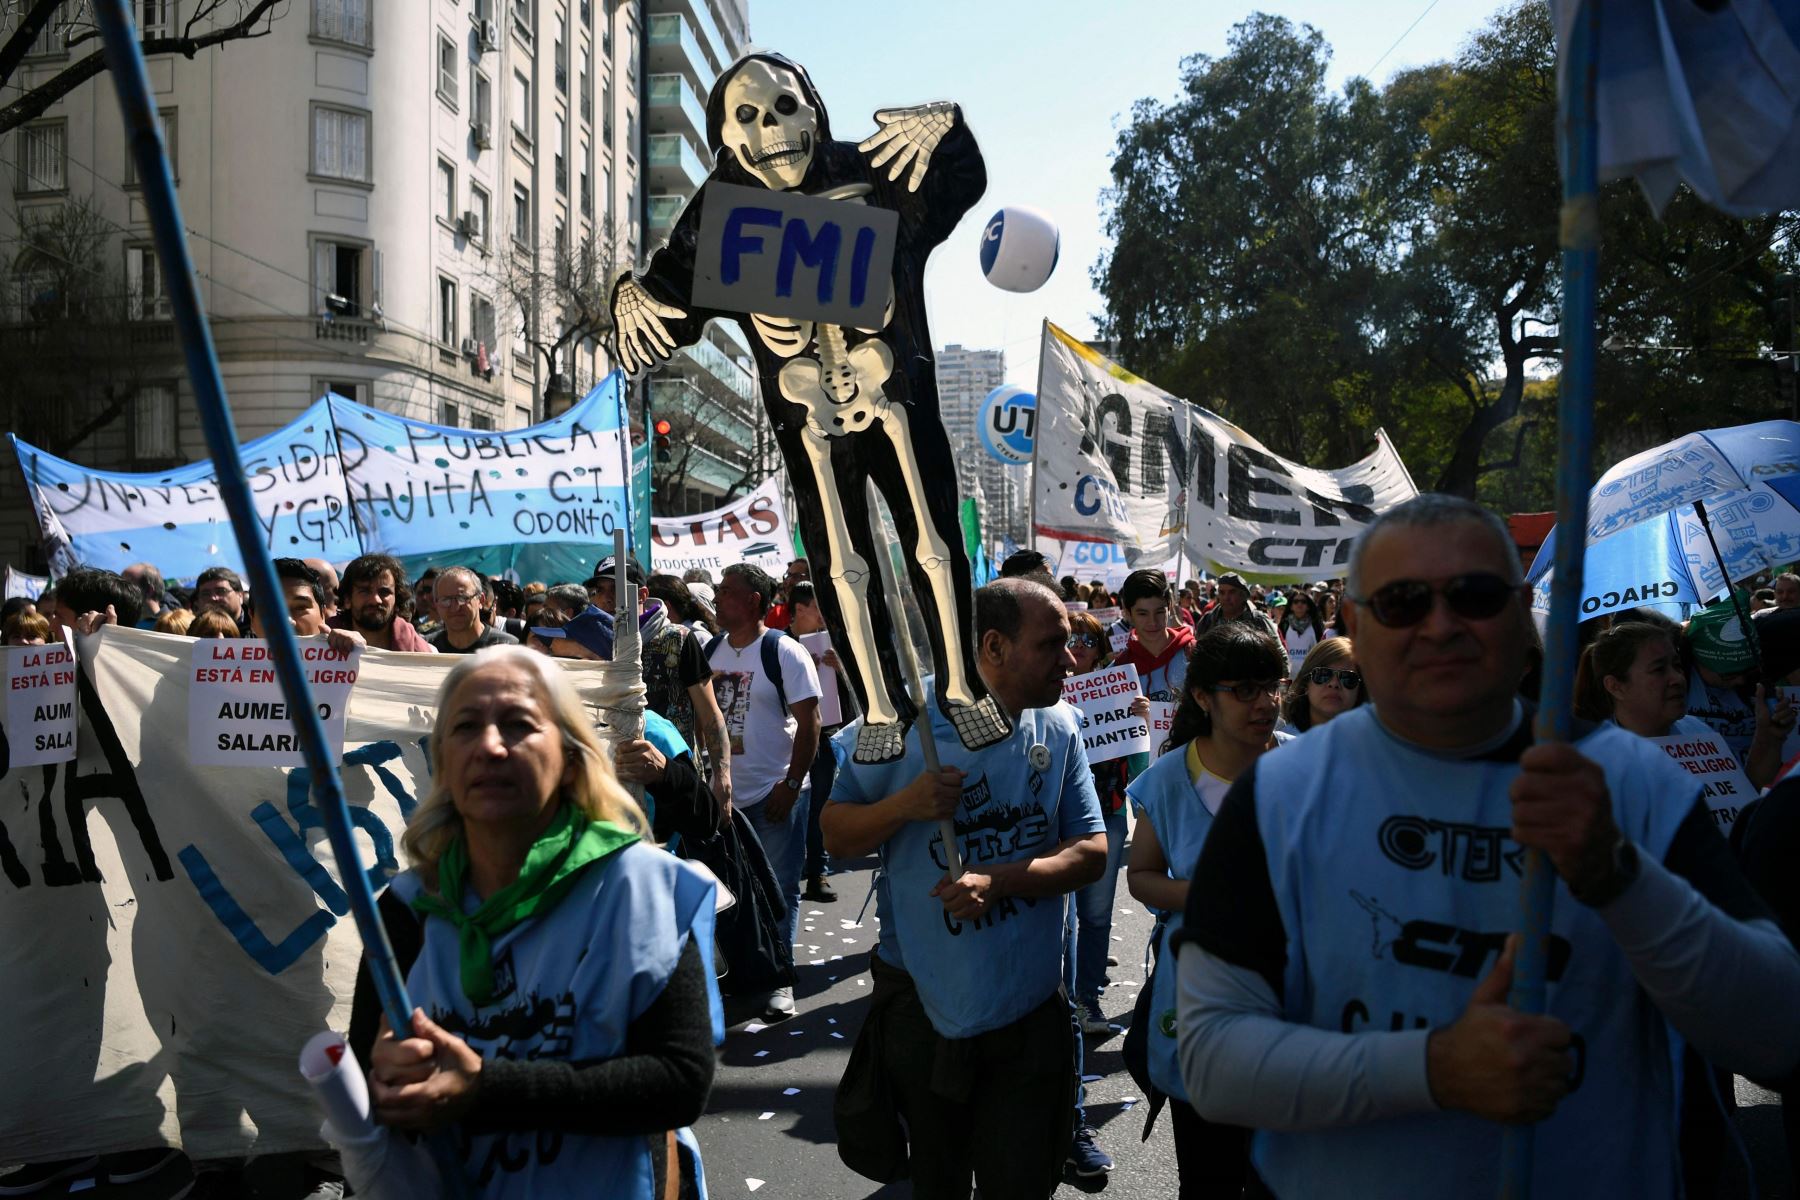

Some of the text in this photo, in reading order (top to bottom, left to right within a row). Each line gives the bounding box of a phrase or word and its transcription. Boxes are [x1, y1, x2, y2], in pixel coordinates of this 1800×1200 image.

[720, 206, 877, 308] FMI
[1078, 393, 1377, 528] GMER
[31, 427, 368, 515] UNIVESIDAD
[513, 507, 614, 537] ODONTO
[23, 654, 41, 668] LA
[212, 646, 236, 660] LA
[11, 670, 74, 690] ESTÁ EN
[196, 667, 243, 683] ESTÁ
[249, 669, 275, 683] EN
[1082, 681, 1138, 702] PELIGRO
[218, 702, 332, 721] AUMEO
[1664, 740, 1719, 759] CACIÓN
[961, 782, 989, 808] CTERA
[1714, 781, 1737, 796] DE
